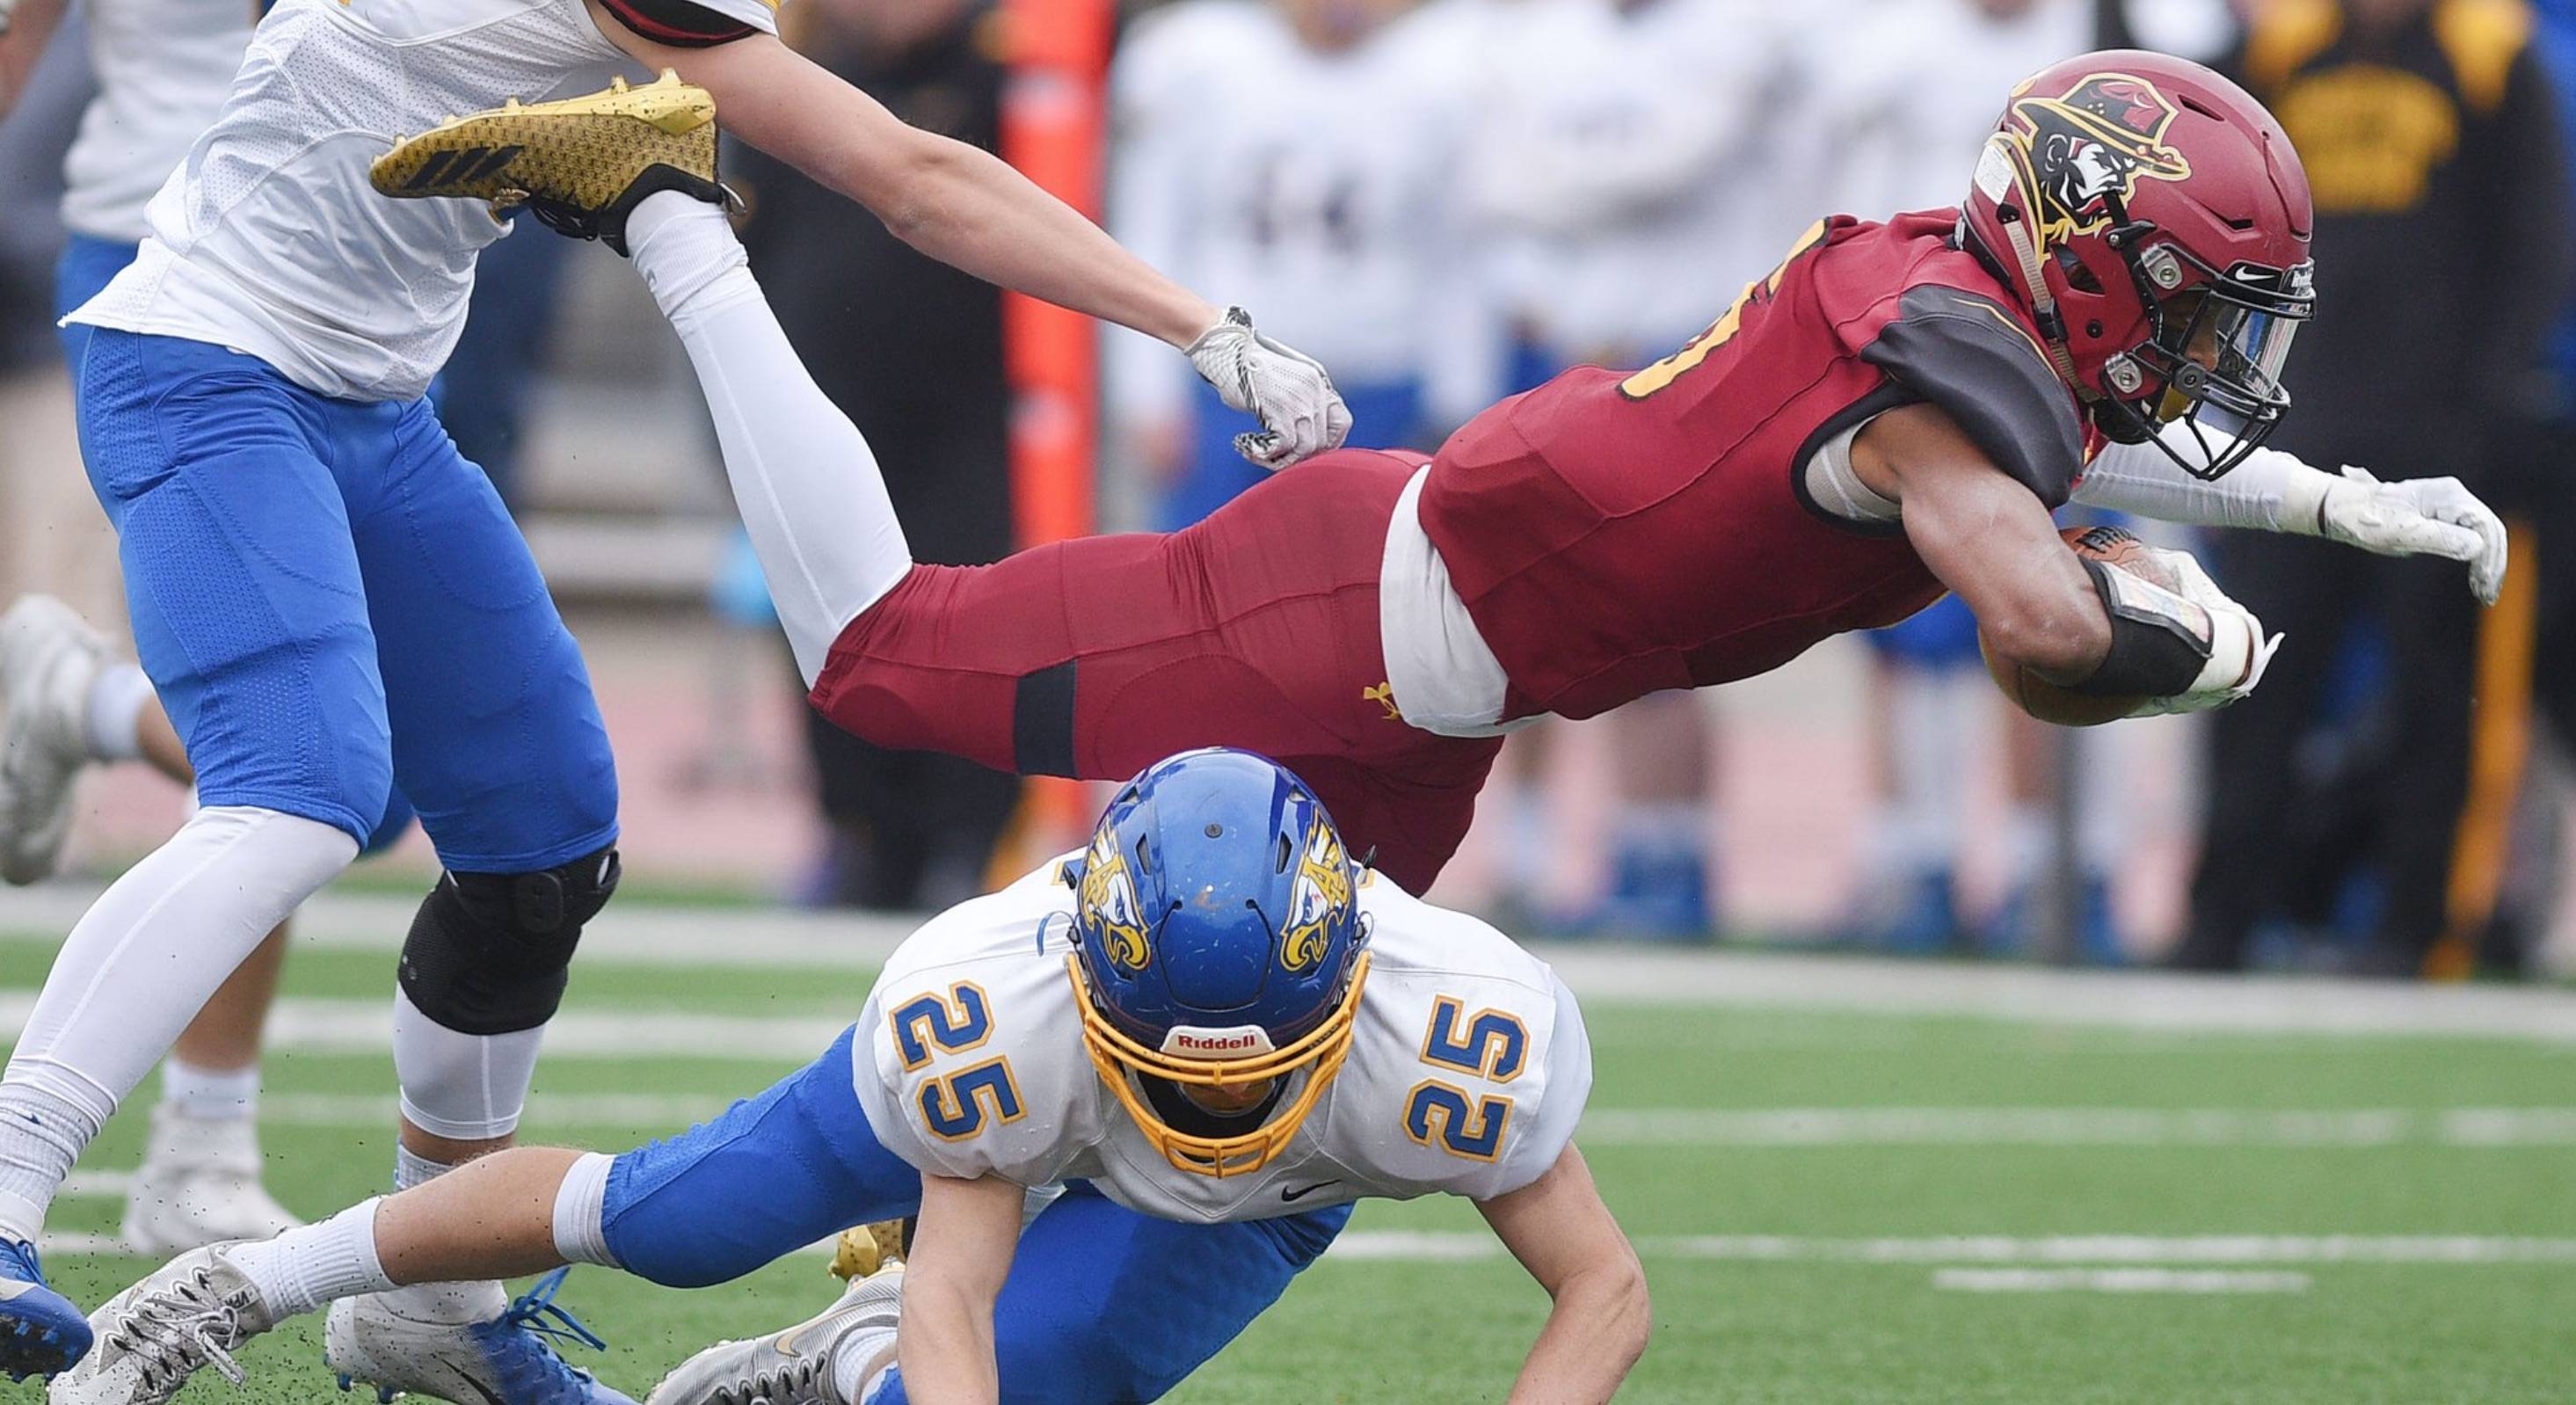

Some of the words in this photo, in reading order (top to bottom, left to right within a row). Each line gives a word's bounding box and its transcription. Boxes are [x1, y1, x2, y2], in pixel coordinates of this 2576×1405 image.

[889, 980, 1027, 1143] 25
[1178, 1034, 1255, 1050] Riddell
[1402, 995, 1532, 1163] 25
